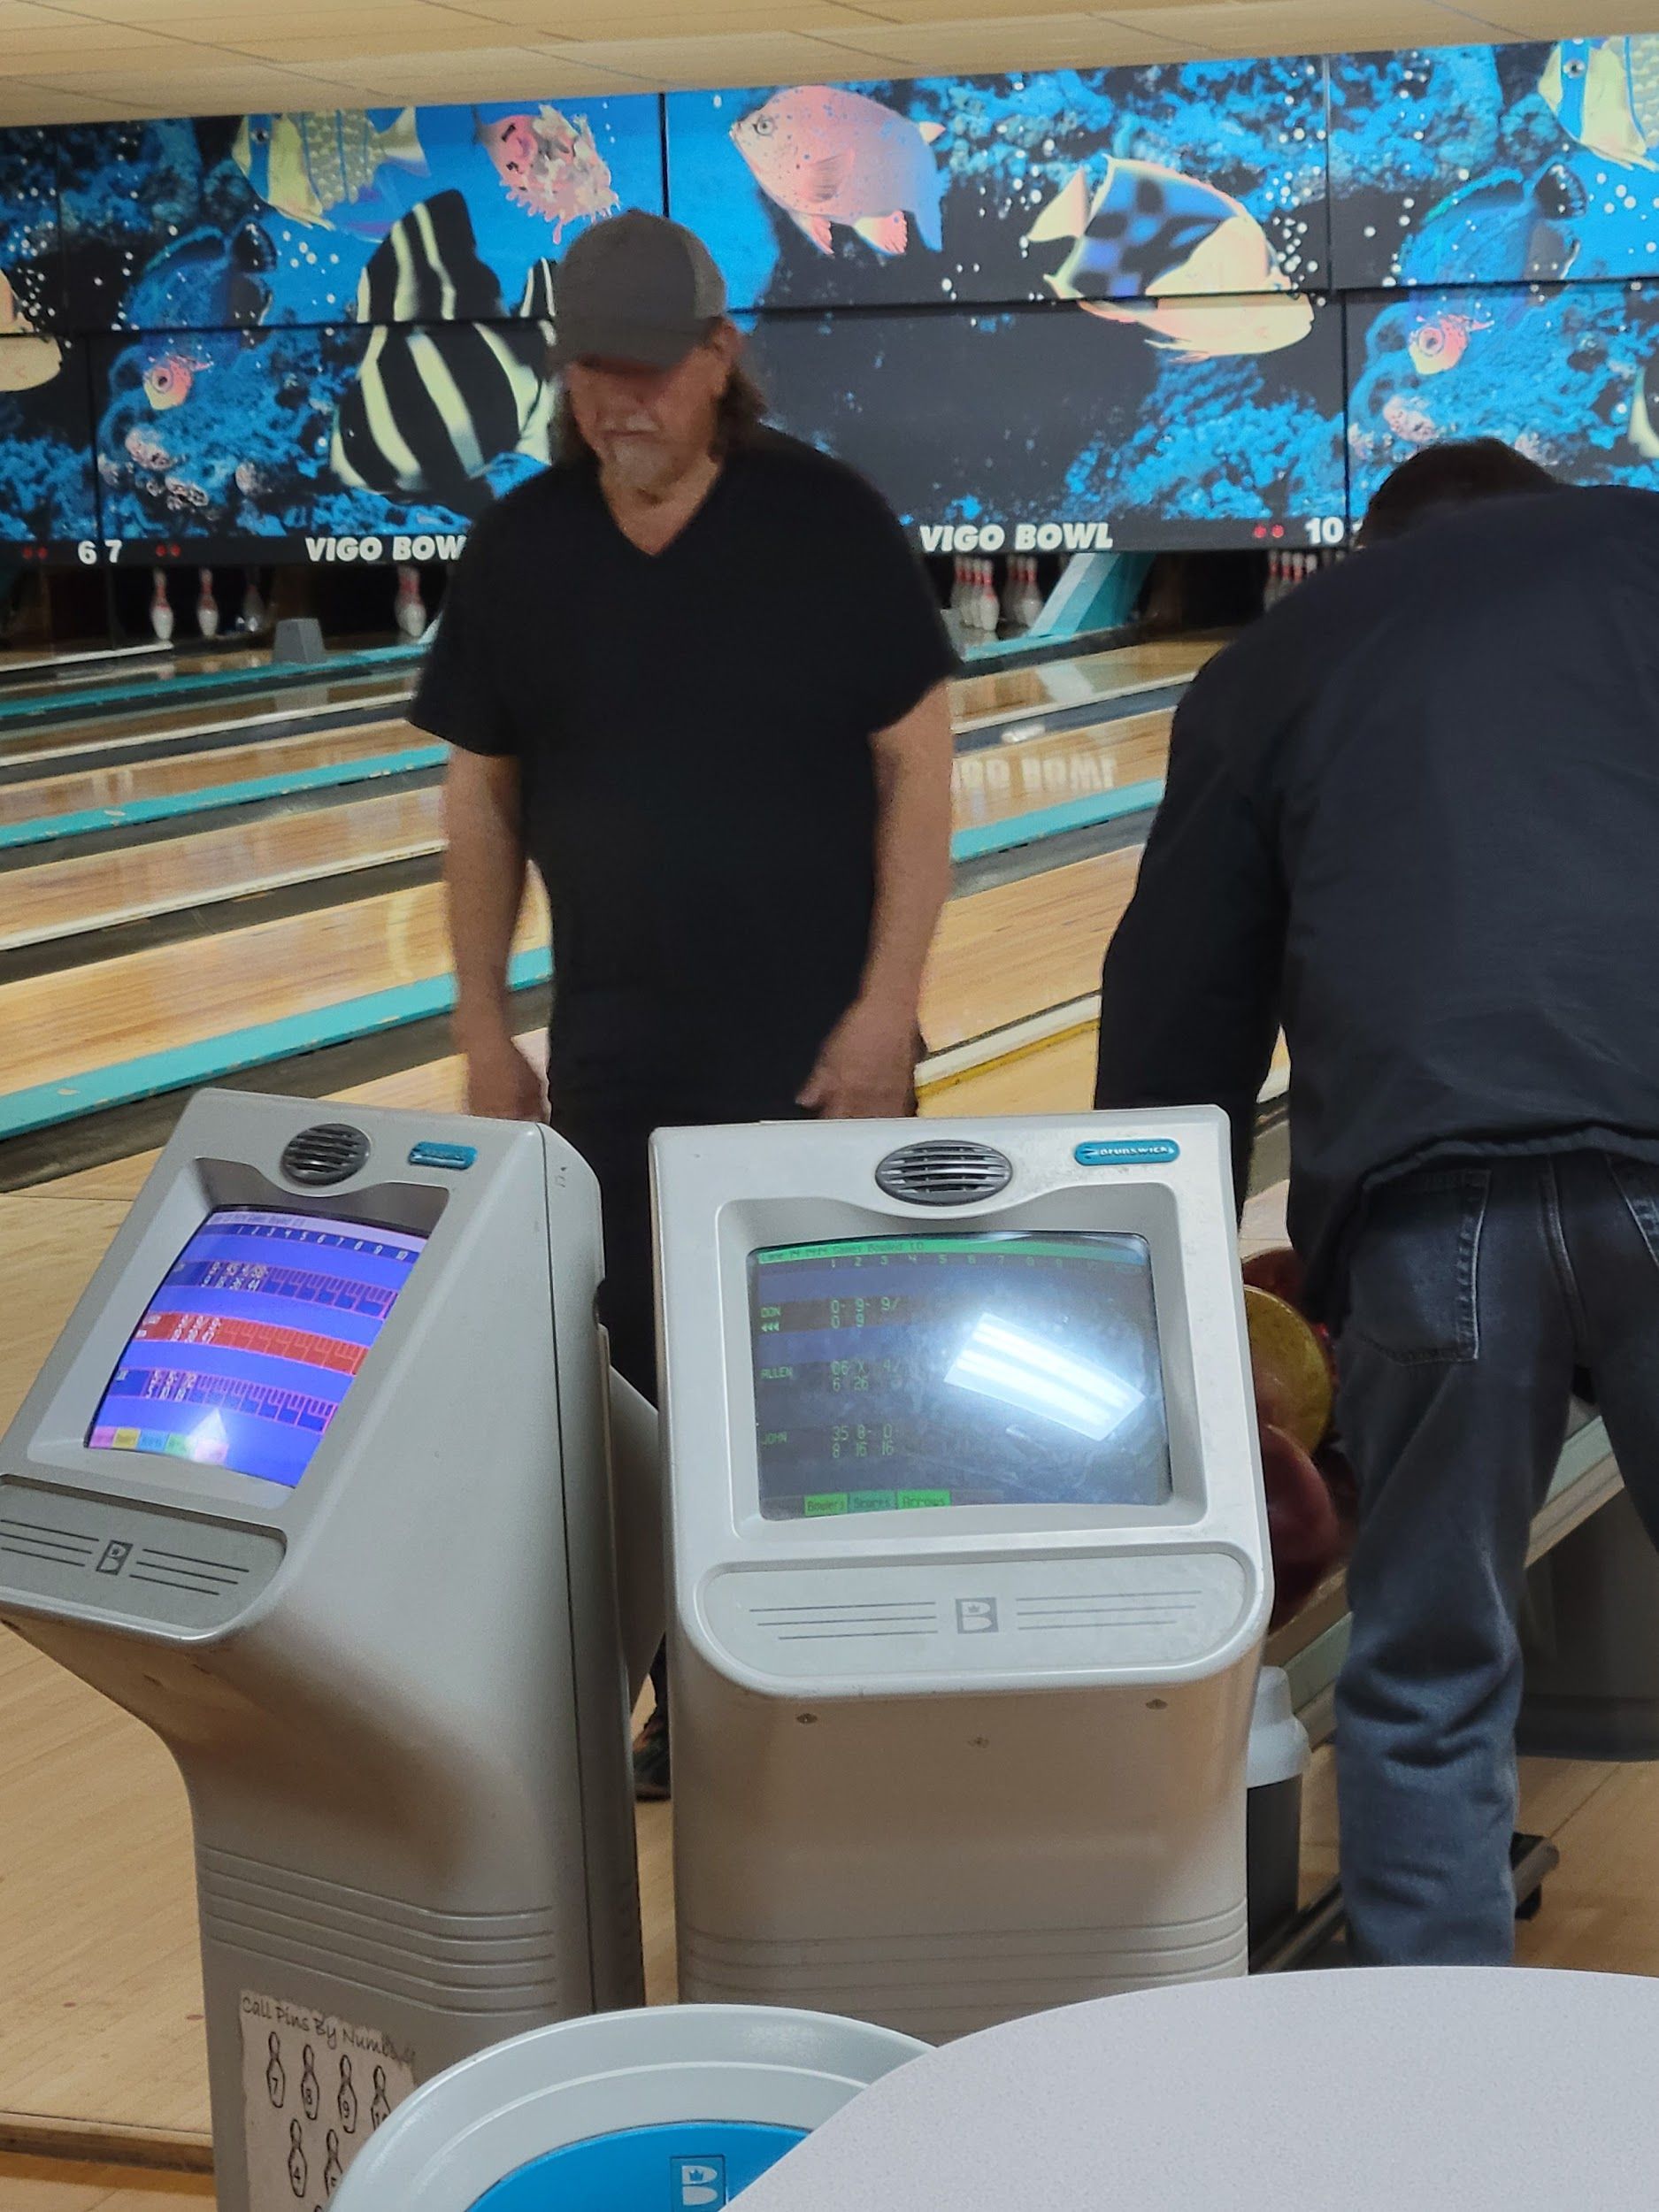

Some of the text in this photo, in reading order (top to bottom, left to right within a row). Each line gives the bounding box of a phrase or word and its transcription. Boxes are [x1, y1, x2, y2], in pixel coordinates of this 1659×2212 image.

[919, 522, 1112, 551] VIGO BOWL
[1305, 517, 1344, 545] 10
[78, 541, 96, 565] 6
[106, 540, 122, 563] 7
[305, 535, 466, 562] VIGO BOW
[242, 1996, 416, 2065] Call Pins By Numb
[272, 2078, 279, 2094] 7
[342, 2101, 350, 2118] 9
[292, 2167, 301, 2185] 4
